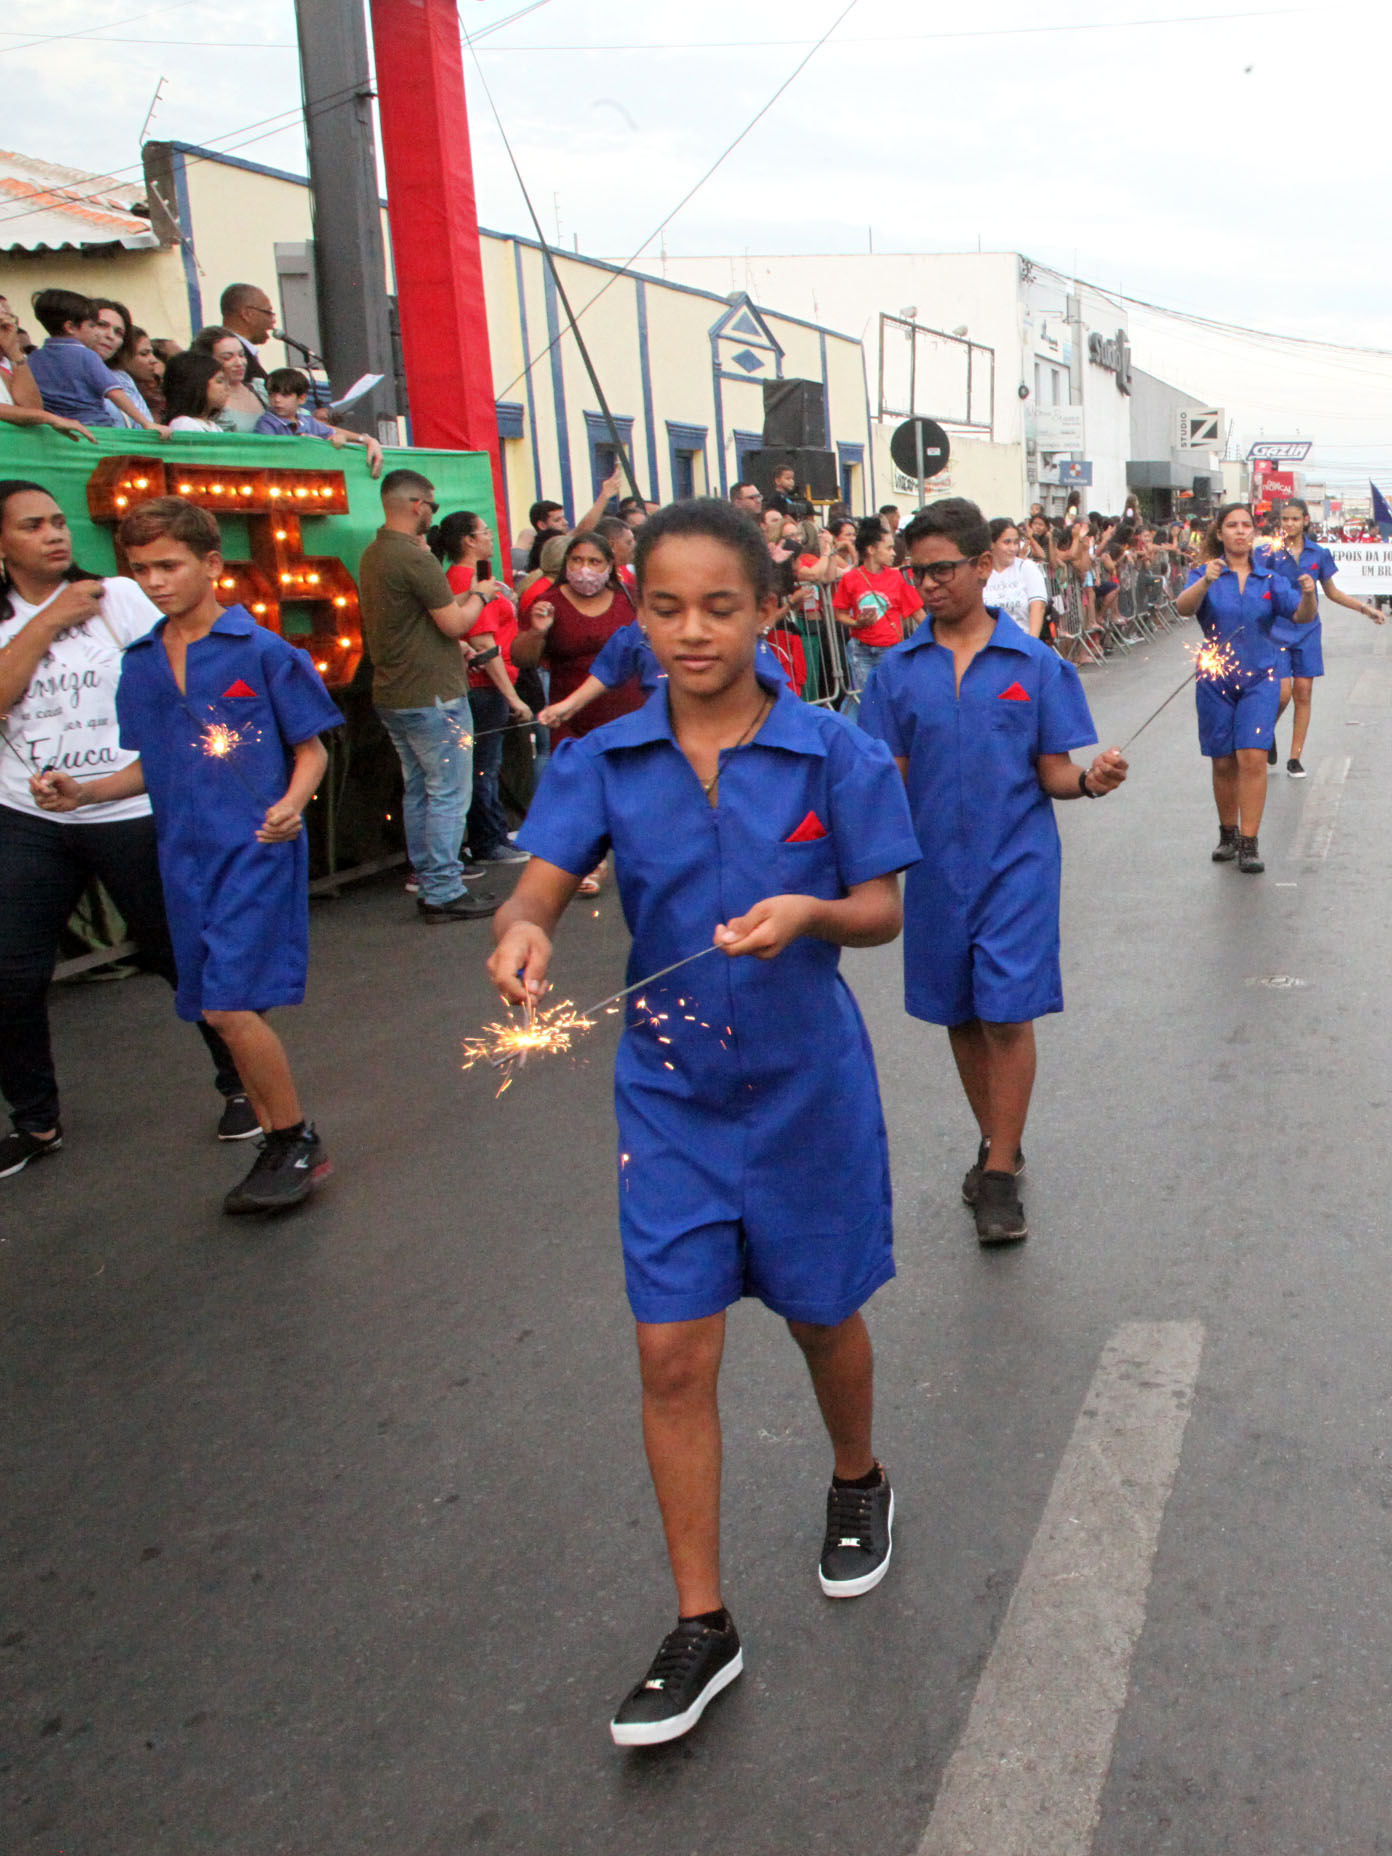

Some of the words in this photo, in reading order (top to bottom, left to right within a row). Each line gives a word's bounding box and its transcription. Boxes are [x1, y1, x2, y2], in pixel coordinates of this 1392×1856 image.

[1332, 551, 1362, 561] EPOIS
[1366, 551, 1380, 561] DA
[1362, 565, 1374, 576] UM
[21, 663, 102, 709] rniza
[26, 734, 118, 772] Educa
